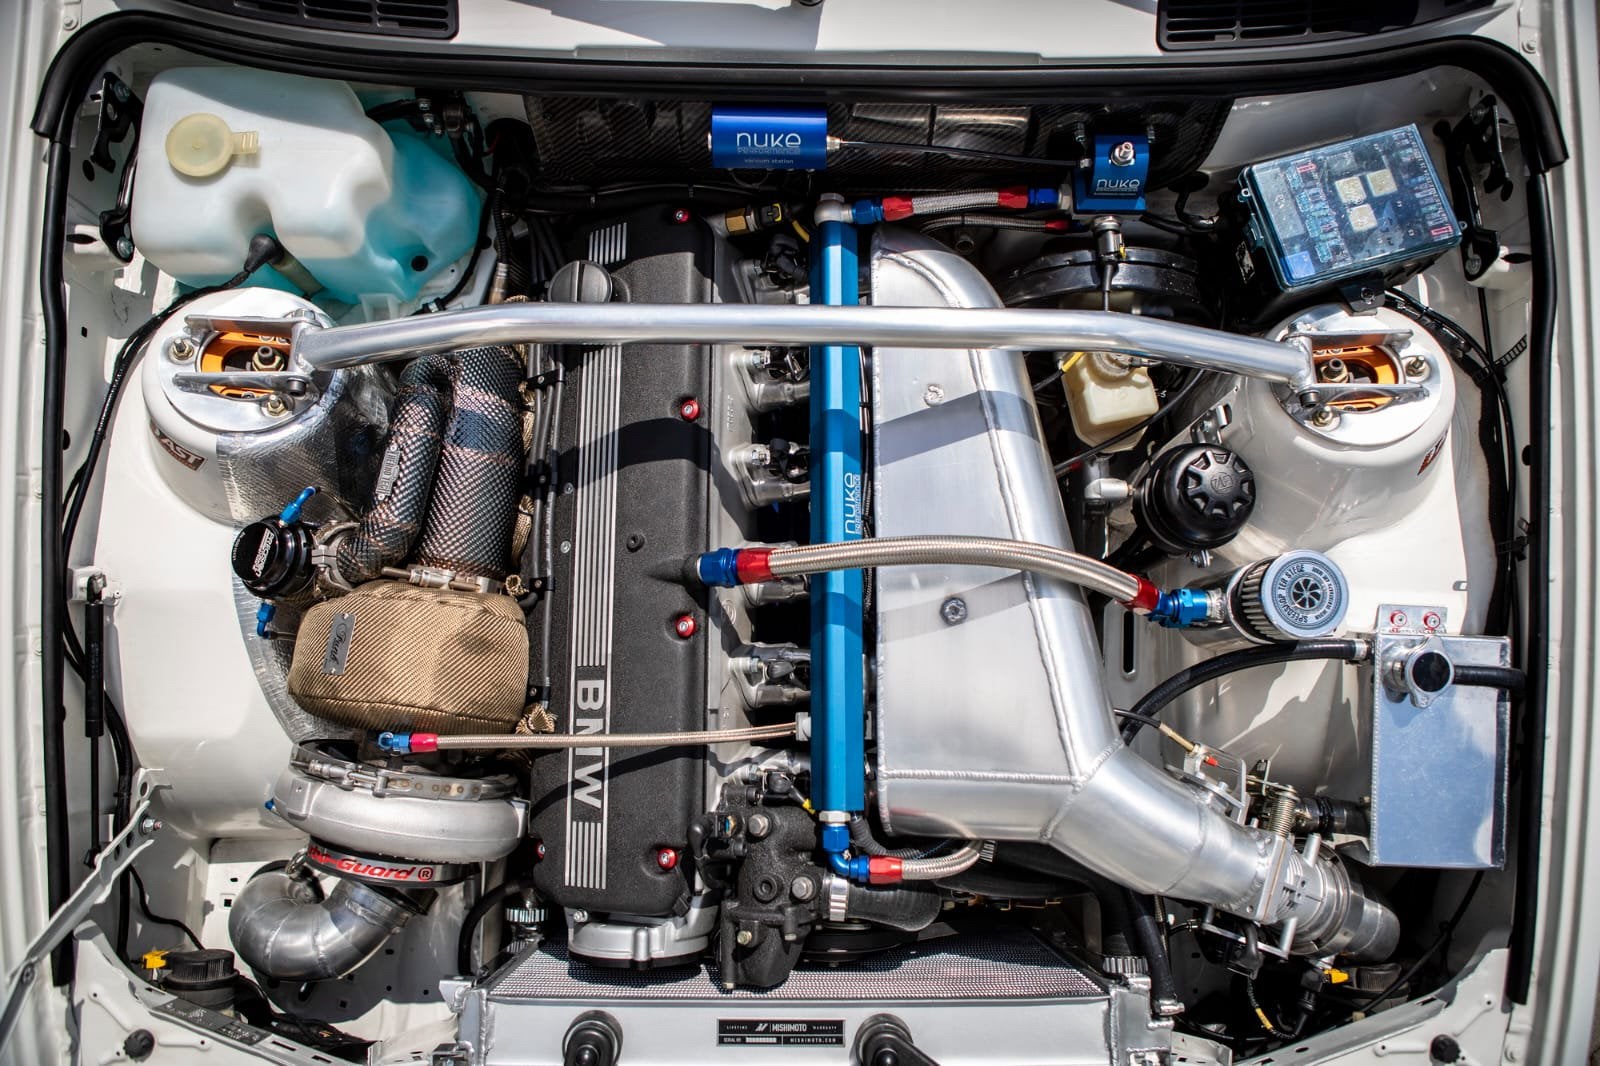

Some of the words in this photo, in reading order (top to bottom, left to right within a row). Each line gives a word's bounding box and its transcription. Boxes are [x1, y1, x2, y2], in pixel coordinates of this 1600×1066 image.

[736, 132, 801, 148] nuke
[1096, 179, 1140, 188] nuke
[844, 472, 856, 534] nuke
[574, 680, 605, 809] BMW
[771, 1023, 808, 1032] MISHIMOTO
